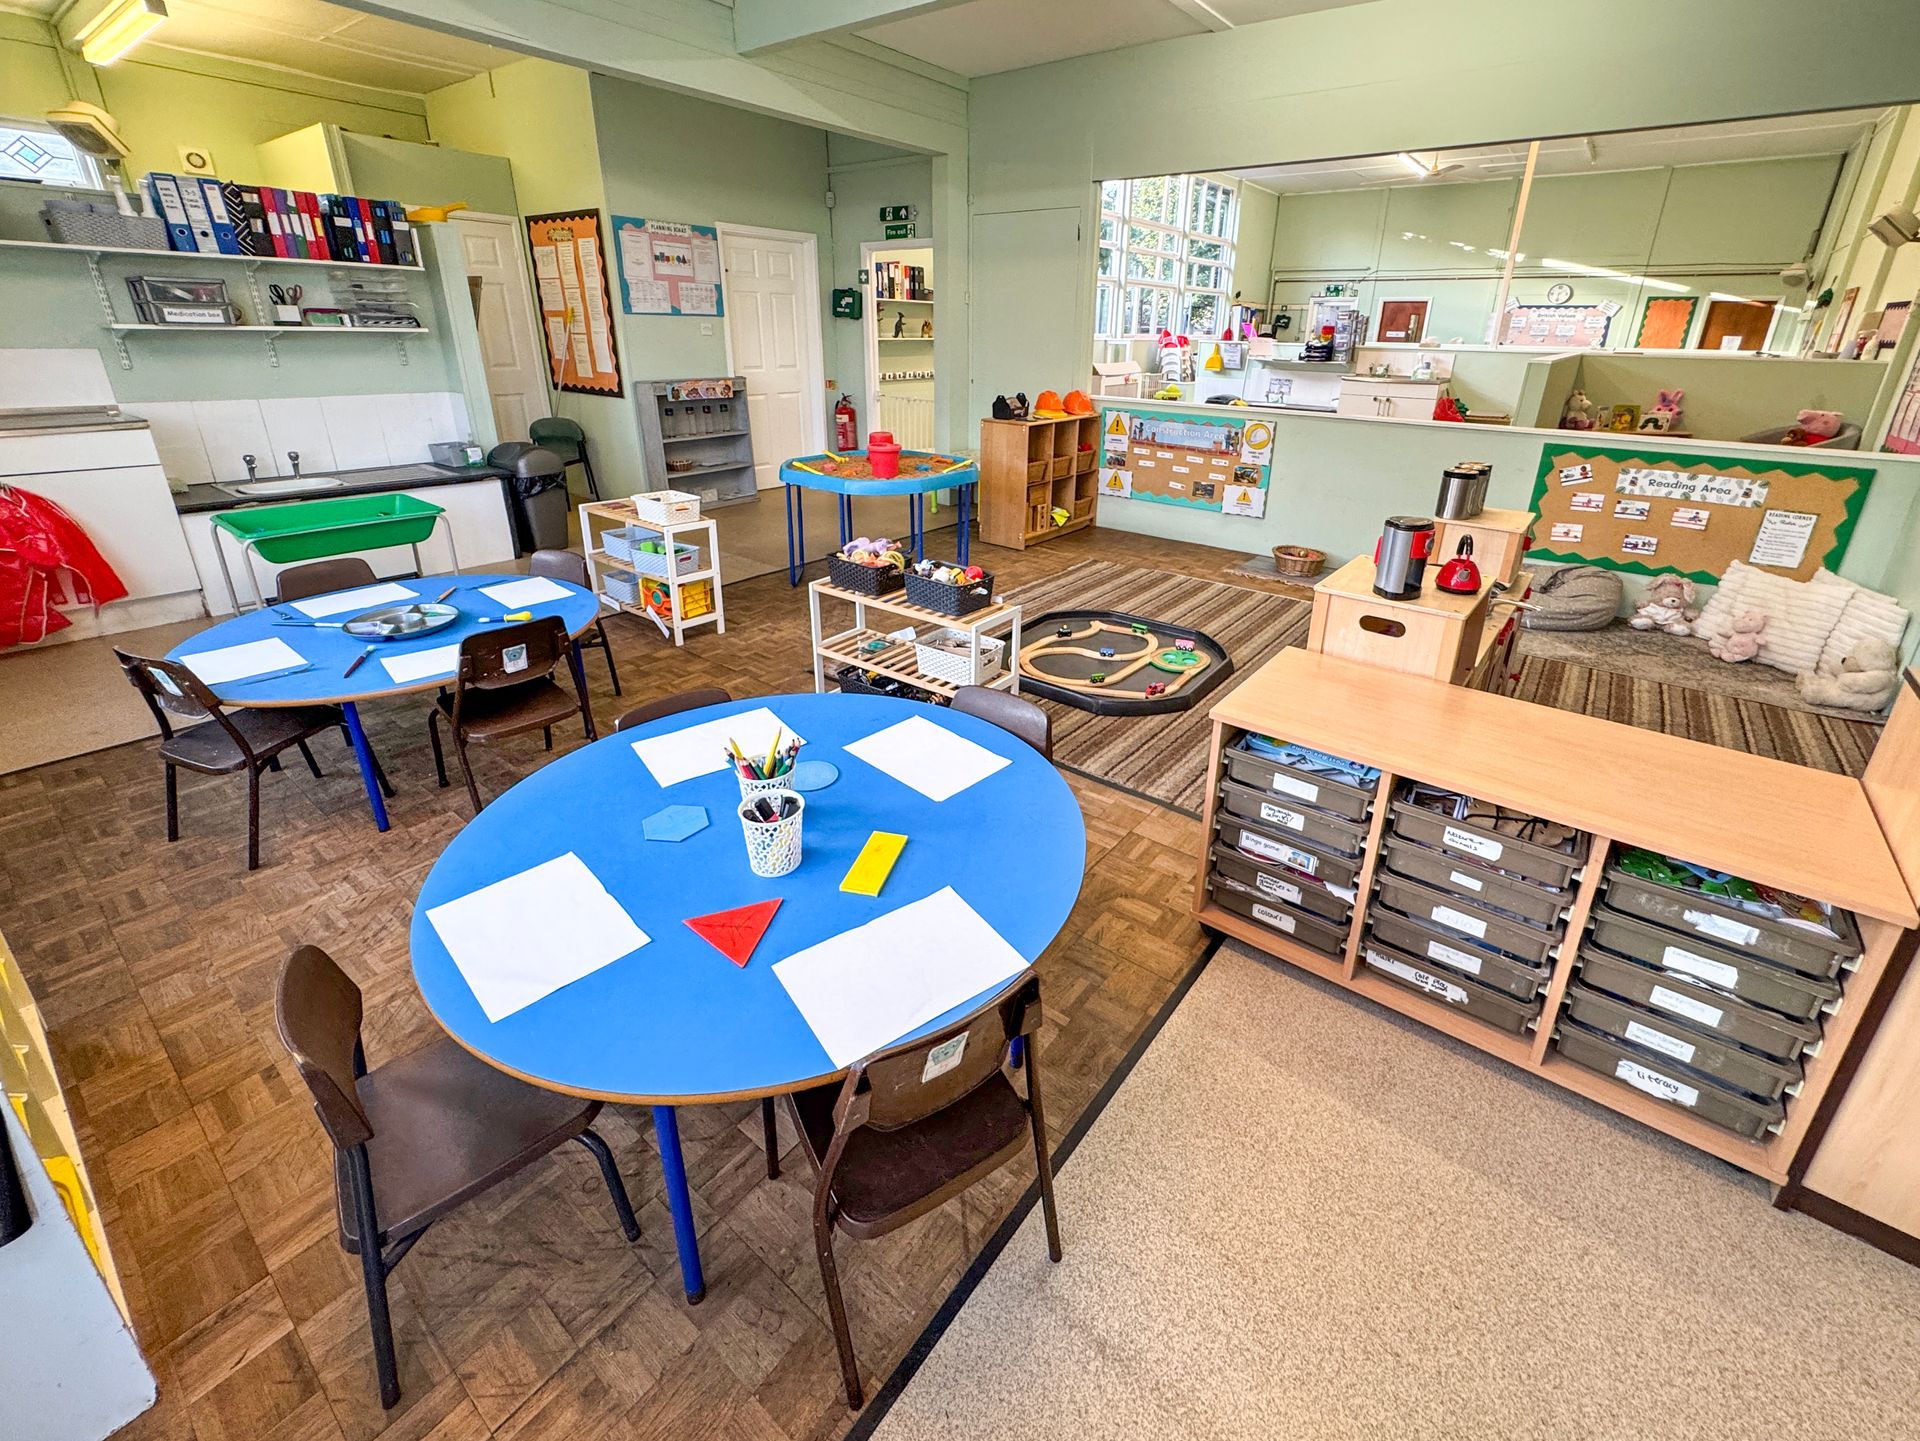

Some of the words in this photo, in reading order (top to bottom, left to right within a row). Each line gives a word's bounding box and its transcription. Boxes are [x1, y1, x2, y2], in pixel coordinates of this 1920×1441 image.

[1145, 424, 1201, 437] Construction
[1204, 430, 1225, 440] Area
[1648, 479, 1696, 493] Reading
[1701, 484, 1732, 495] Area
[1245, 834, 1262, 846] Bingo
[1263, 842, 1280, 851] game
